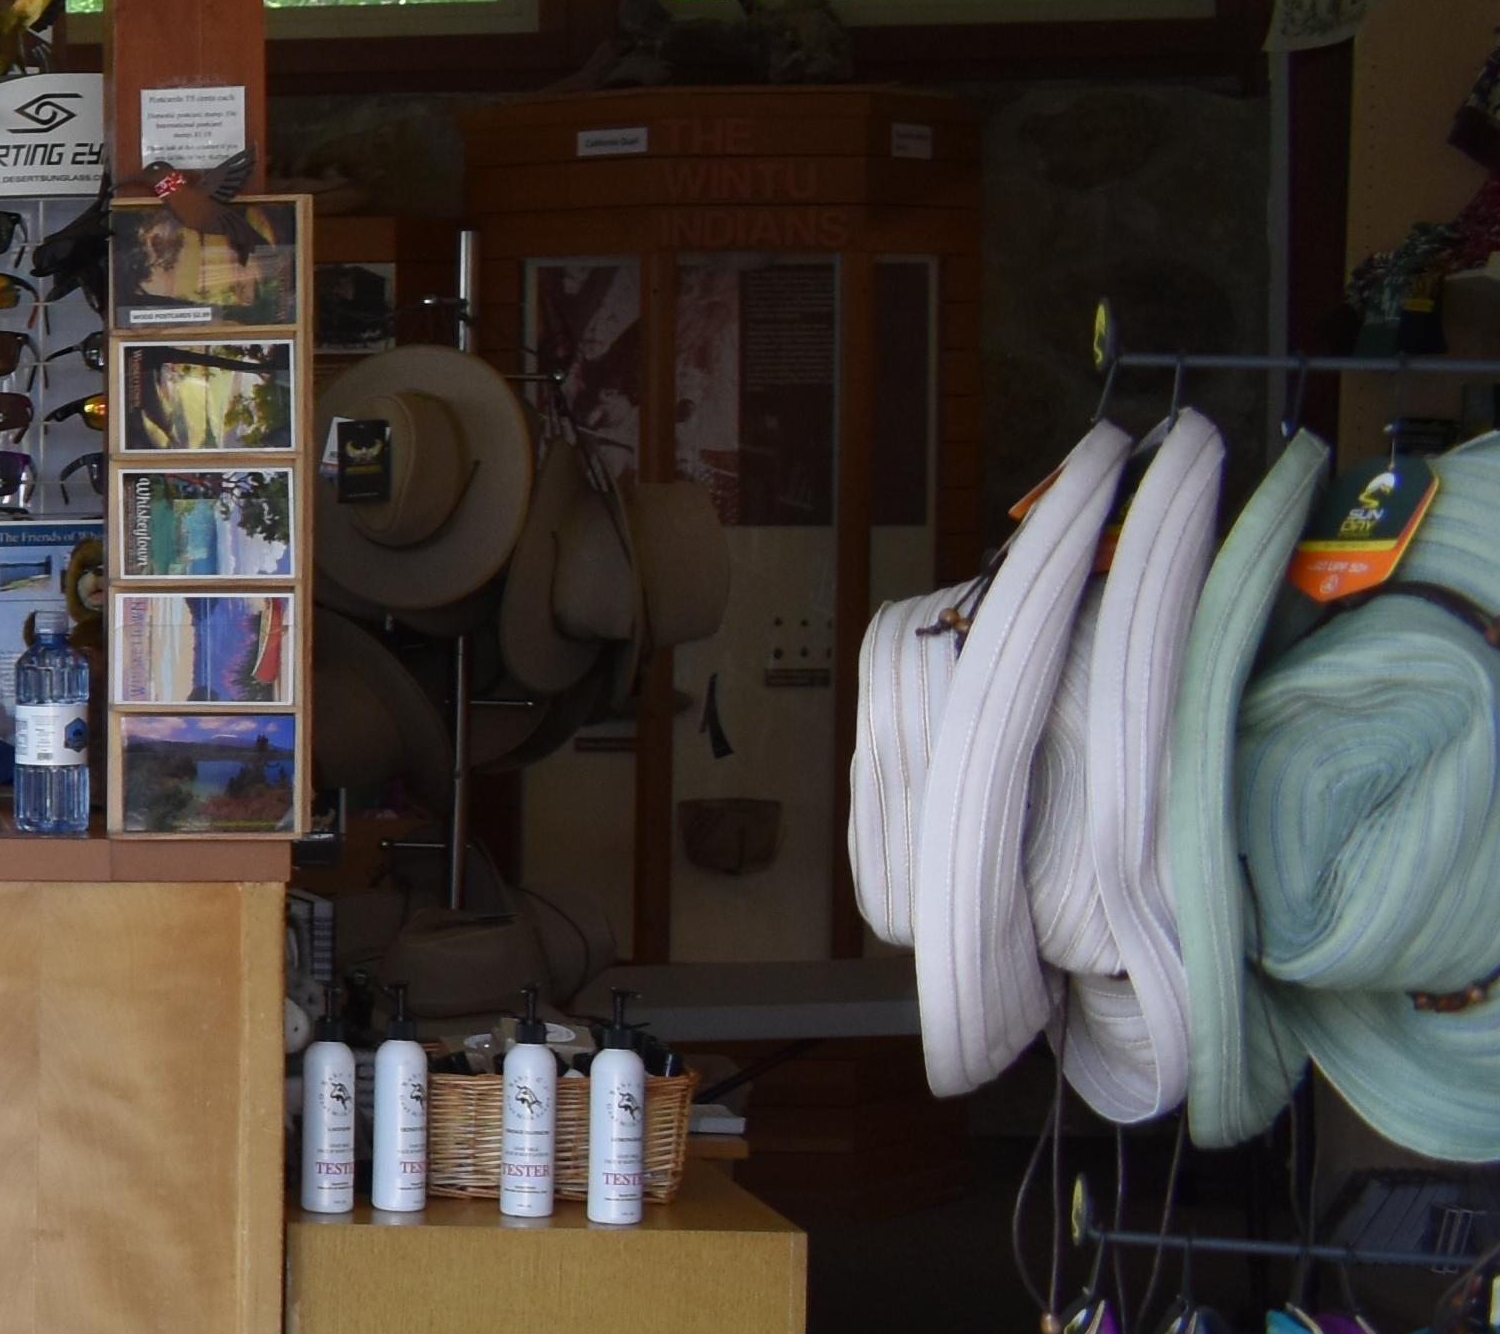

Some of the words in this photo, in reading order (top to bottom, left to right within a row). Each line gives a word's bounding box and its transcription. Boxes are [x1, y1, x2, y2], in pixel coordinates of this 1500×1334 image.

[665, 118, 752, 153] THE
[71, 143, 106, 165] EY
[665, 162, 818, 199] WINTU
[659, 210, 849, 248] INDIANS
[132, 477, 151, 567] Whiskeytown
[22, 531, 61, 542] Friends
[63, 531, 76, 540] of
[316, 1161, 354, 1175] TESTE
[502, 1163, 550, 1177] TESTER
[602, 1172, 644, 1186] TESTE
